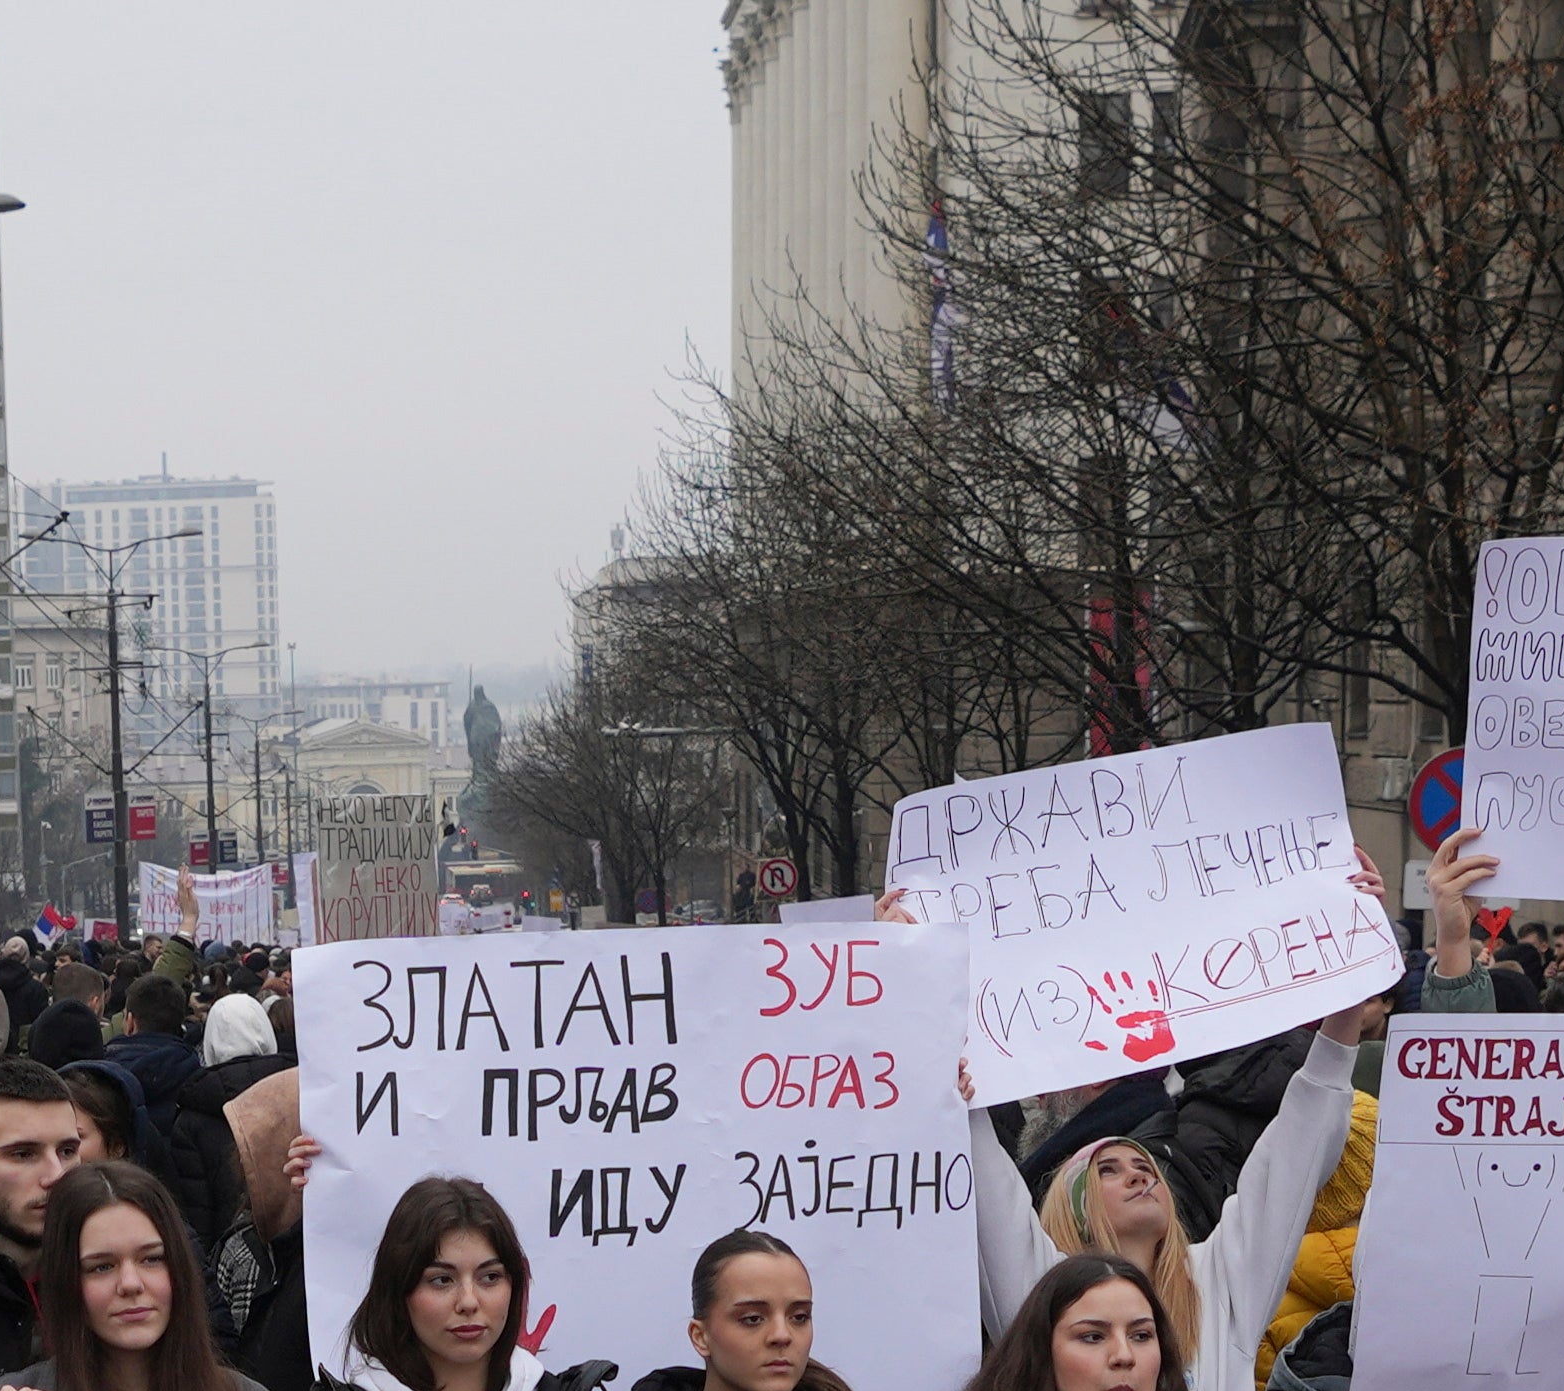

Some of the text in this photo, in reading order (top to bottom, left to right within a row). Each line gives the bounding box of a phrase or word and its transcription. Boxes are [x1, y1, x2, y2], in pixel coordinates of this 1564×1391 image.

[320, 796, 366, 825] НЕКО
[321, 827, 438, 865] ТРАДИЦИЈУ
[891, 757, 1197, 884] ДРЖАВИ
[350, 863, 422, 896] А НЕКО
[898, 812, 1350, 940] ТРЕБА ЛЕЧЕЊЕ
[352, 937, 884, 1052] ЗЛАТАН ЗУБ
[356, 1051, 900, 1141] И ПРЉАВ ОБРАЗ
[549, 1138, 972, 1247] ИДУ ЗАЈЕДНО
